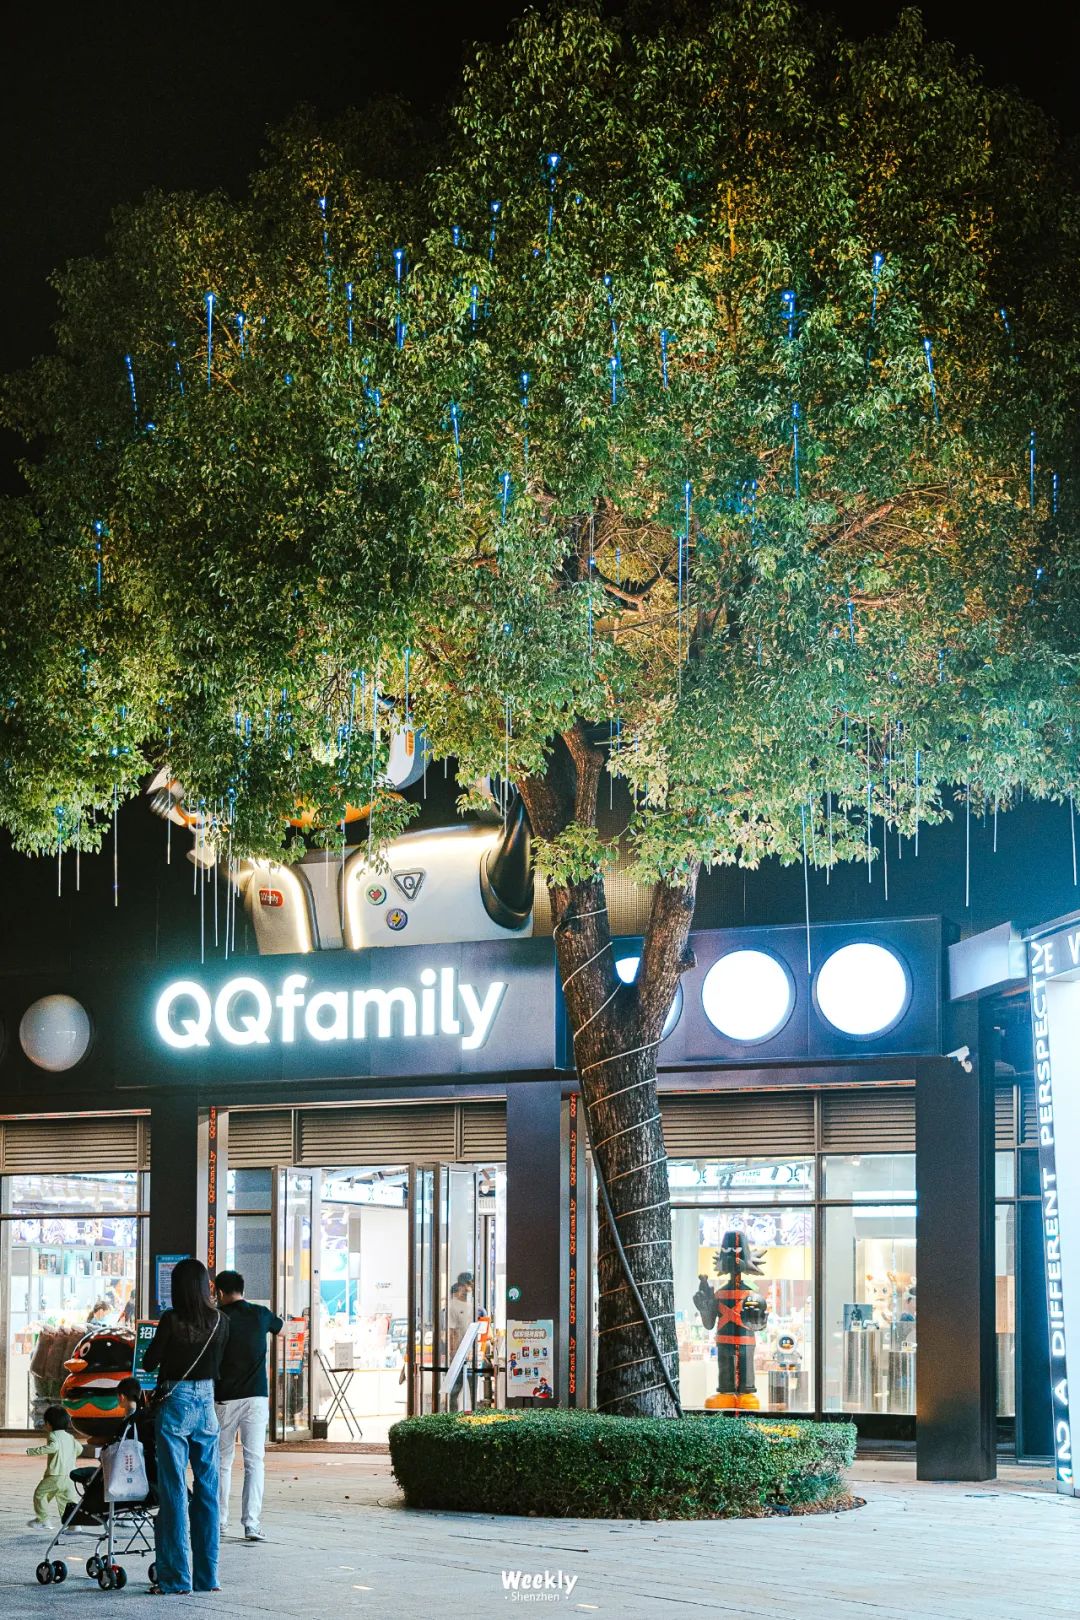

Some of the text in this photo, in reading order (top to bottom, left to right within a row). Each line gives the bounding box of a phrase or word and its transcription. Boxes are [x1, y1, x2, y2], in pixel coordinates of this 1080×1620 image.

[403, 876, 415, 890] Q
[155, 967, 508, 1050] QQfamily
[1031, 941, 1055, 1146] PERSPECTIVE
[1043, 1167, 1066, 1357] DIFFERENT
[1054, 1378, 1068, 1406] A
